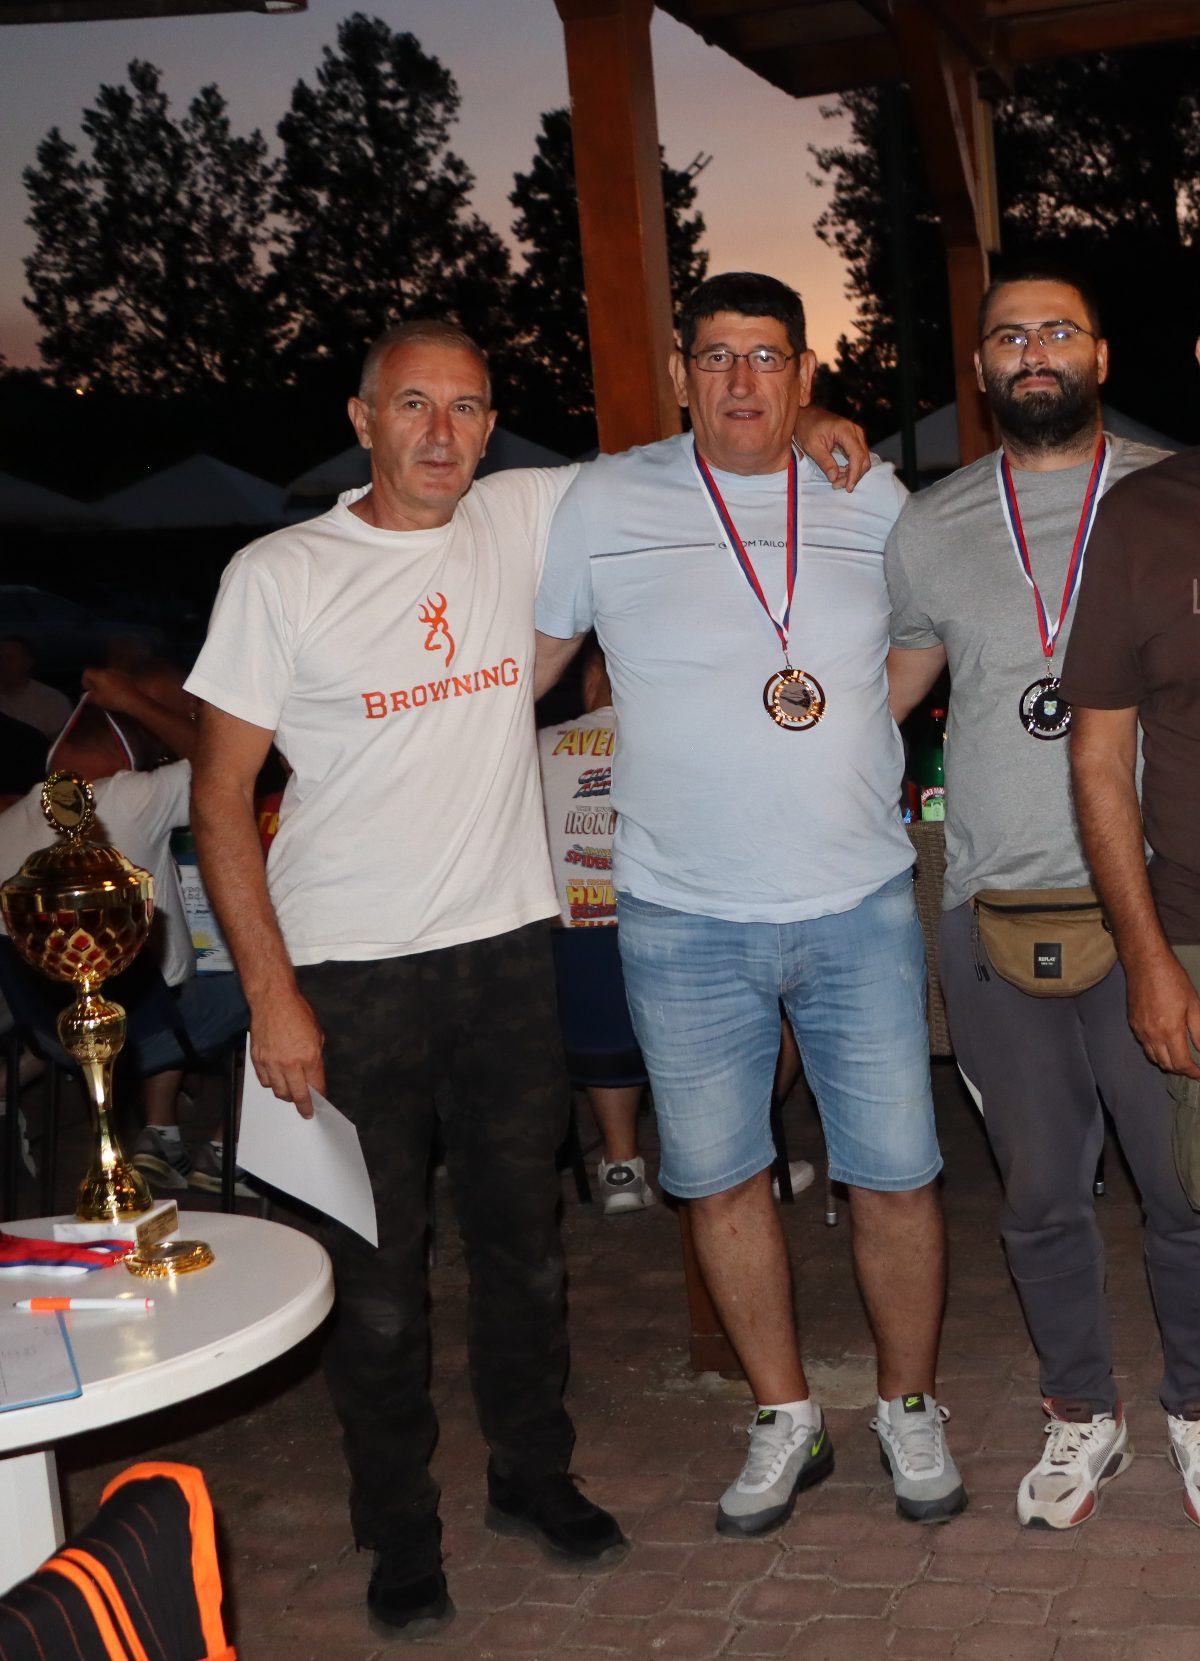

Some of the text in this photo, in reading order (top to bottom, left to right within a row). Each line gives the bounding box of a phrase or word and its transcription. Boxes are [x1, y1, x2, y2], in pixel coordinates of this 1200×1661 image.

[741, 540, 788, 548] OM TAILO
[361, 657, 520, 719] BROWNING
